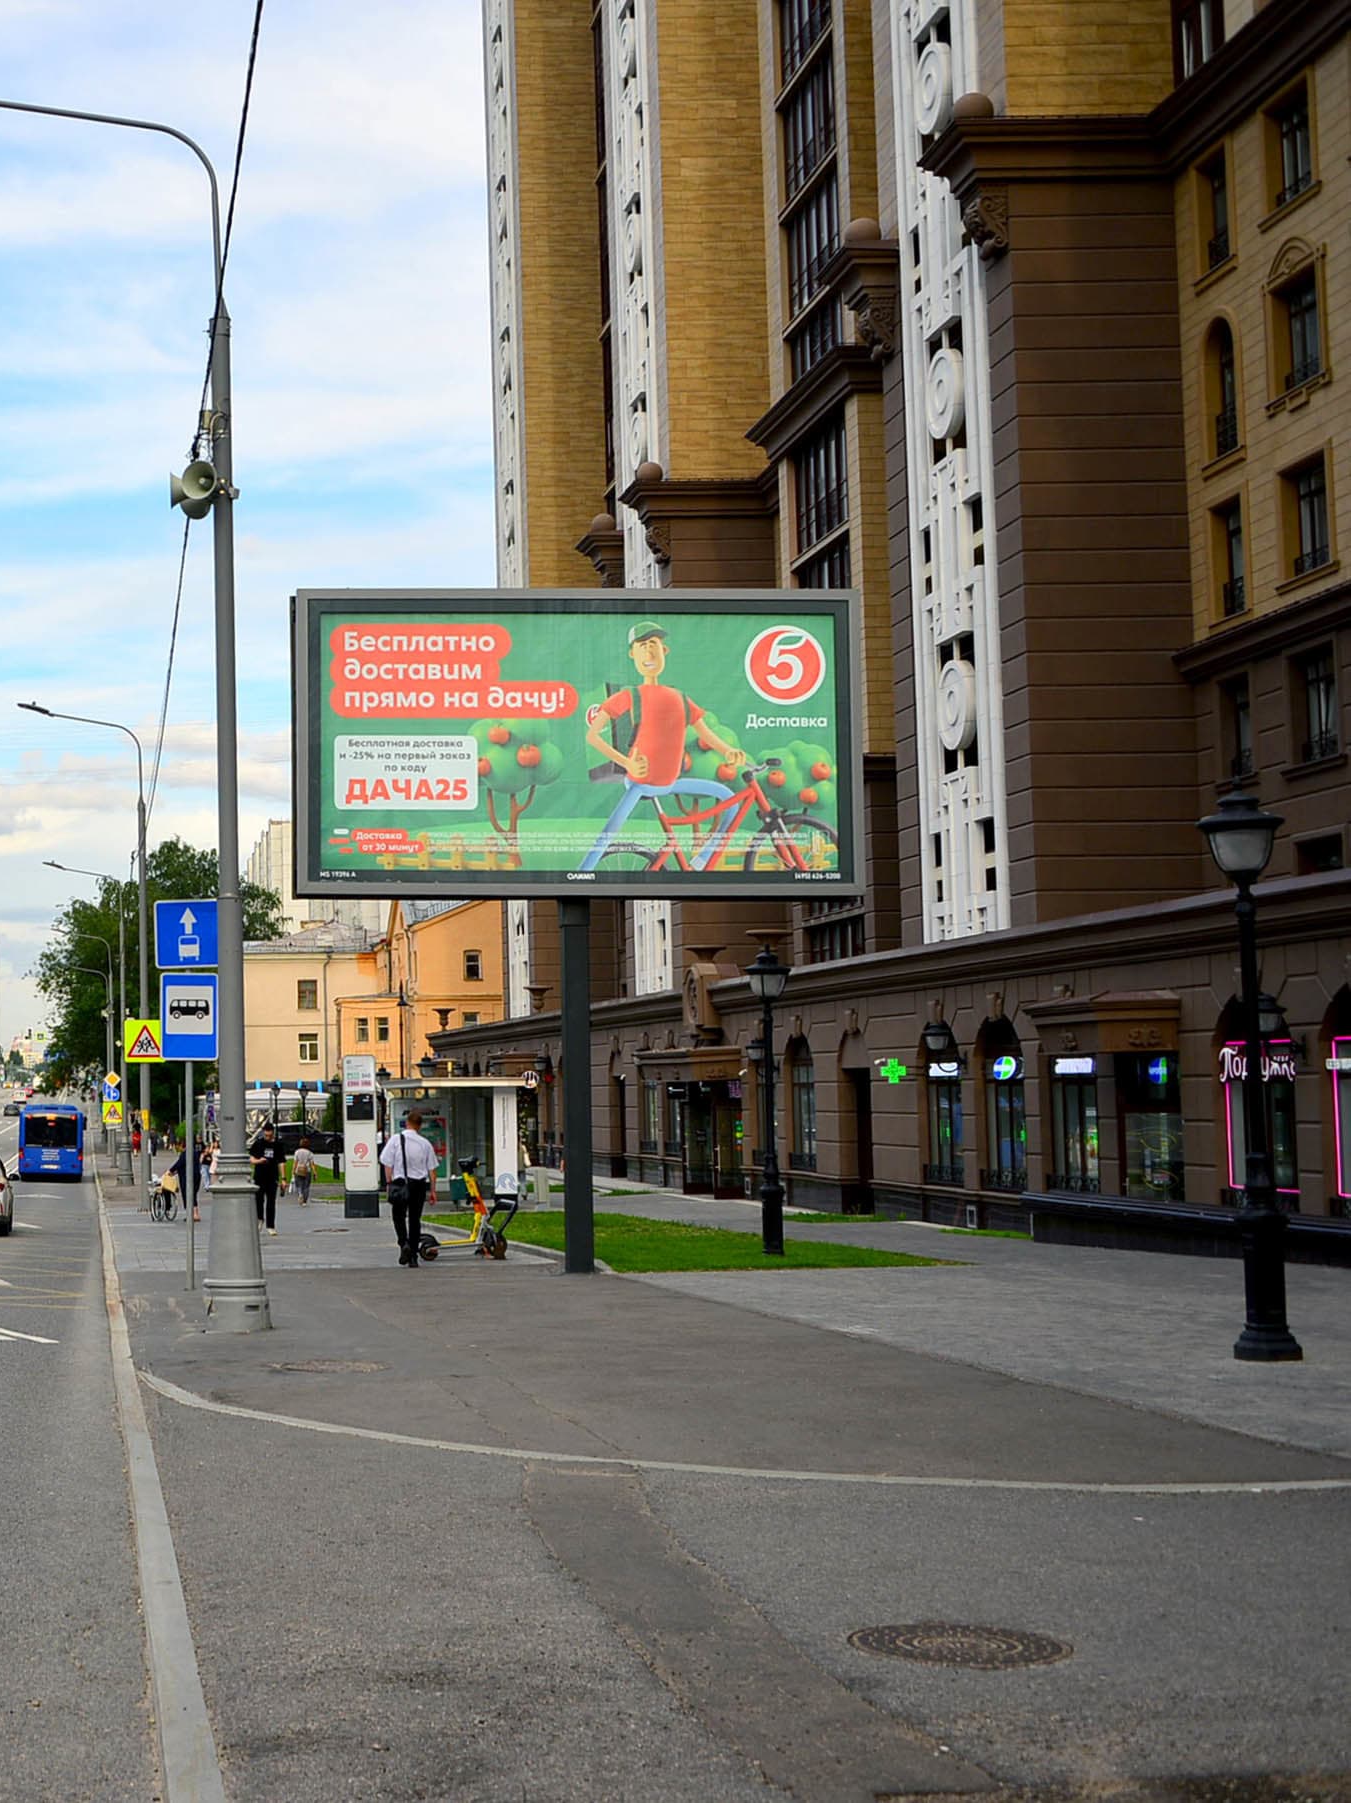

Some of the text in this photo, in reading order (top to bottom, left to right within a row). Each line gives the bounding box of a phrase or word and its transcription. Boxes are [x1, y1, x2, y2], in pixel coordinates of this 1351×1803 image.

[343, 631, 496, 652] Бесплатно
[343, 658, 482, 680] доставим
[344, 686, 566, 713] прямо на дачу!
[745, 713, 828, 729] Доставка
[348, 738, 464, 749] Бесплатная доставка
[339, 750, 472, 761] и -25% на первый заказ
[384, 764, 428, 774] по коду
[345, 778, 469, 805] ДАЧА25
[355, 832, 403, 841] Доставка
[375, 842, 387, 851] 30
[388, 844, 419, 853] минут
